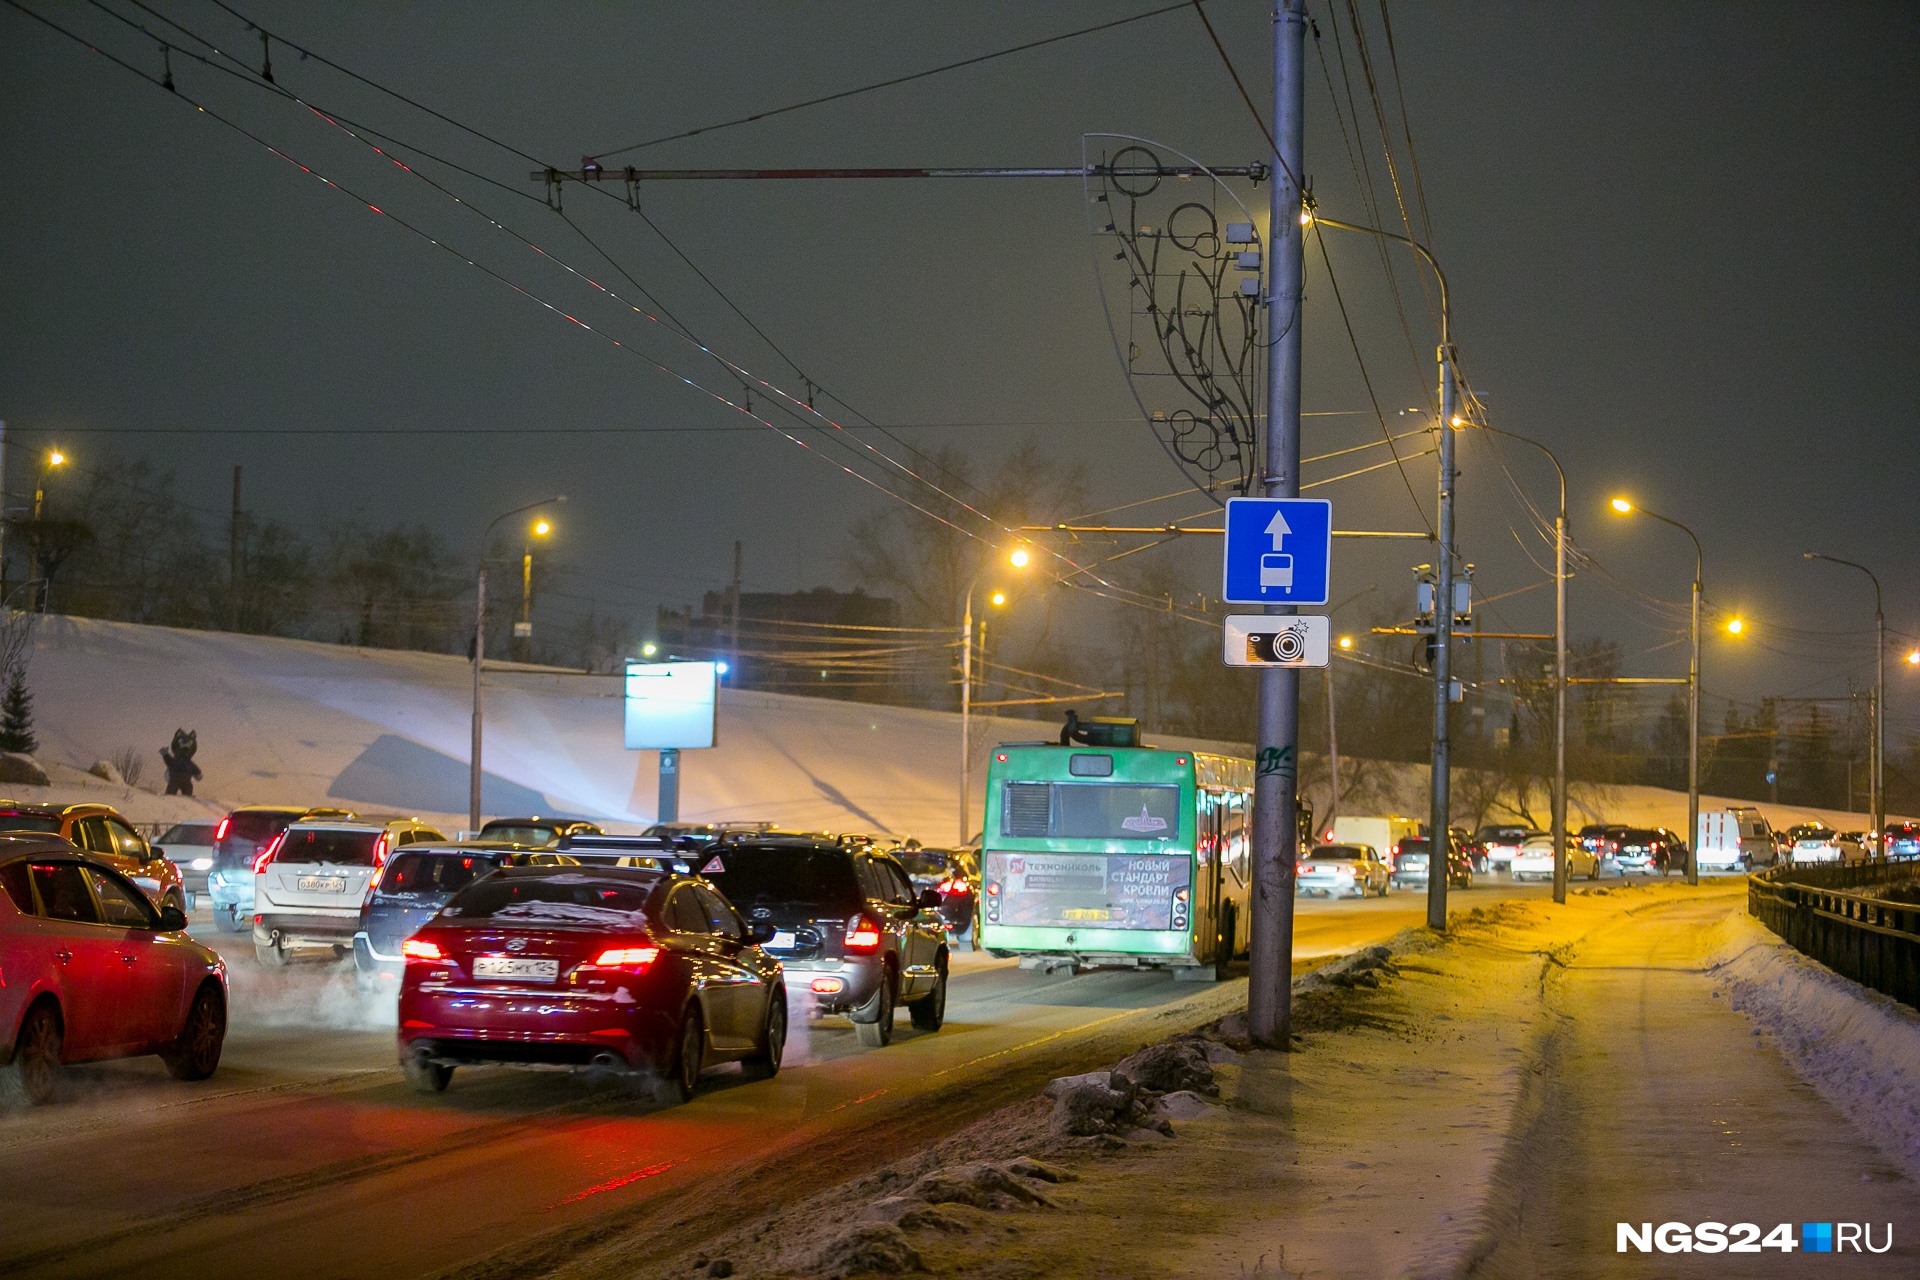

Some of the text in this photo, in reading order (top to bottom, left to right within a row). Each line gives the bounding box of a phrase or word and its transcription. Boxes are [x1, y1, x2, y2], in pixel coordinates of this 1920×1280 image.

[1128, 859, 1170, 871] НОВЫЙ
[1112, 872, 1169, 884] СТАНДАРТ
[1123, 884, 1169, 896] КРОВЛИ
